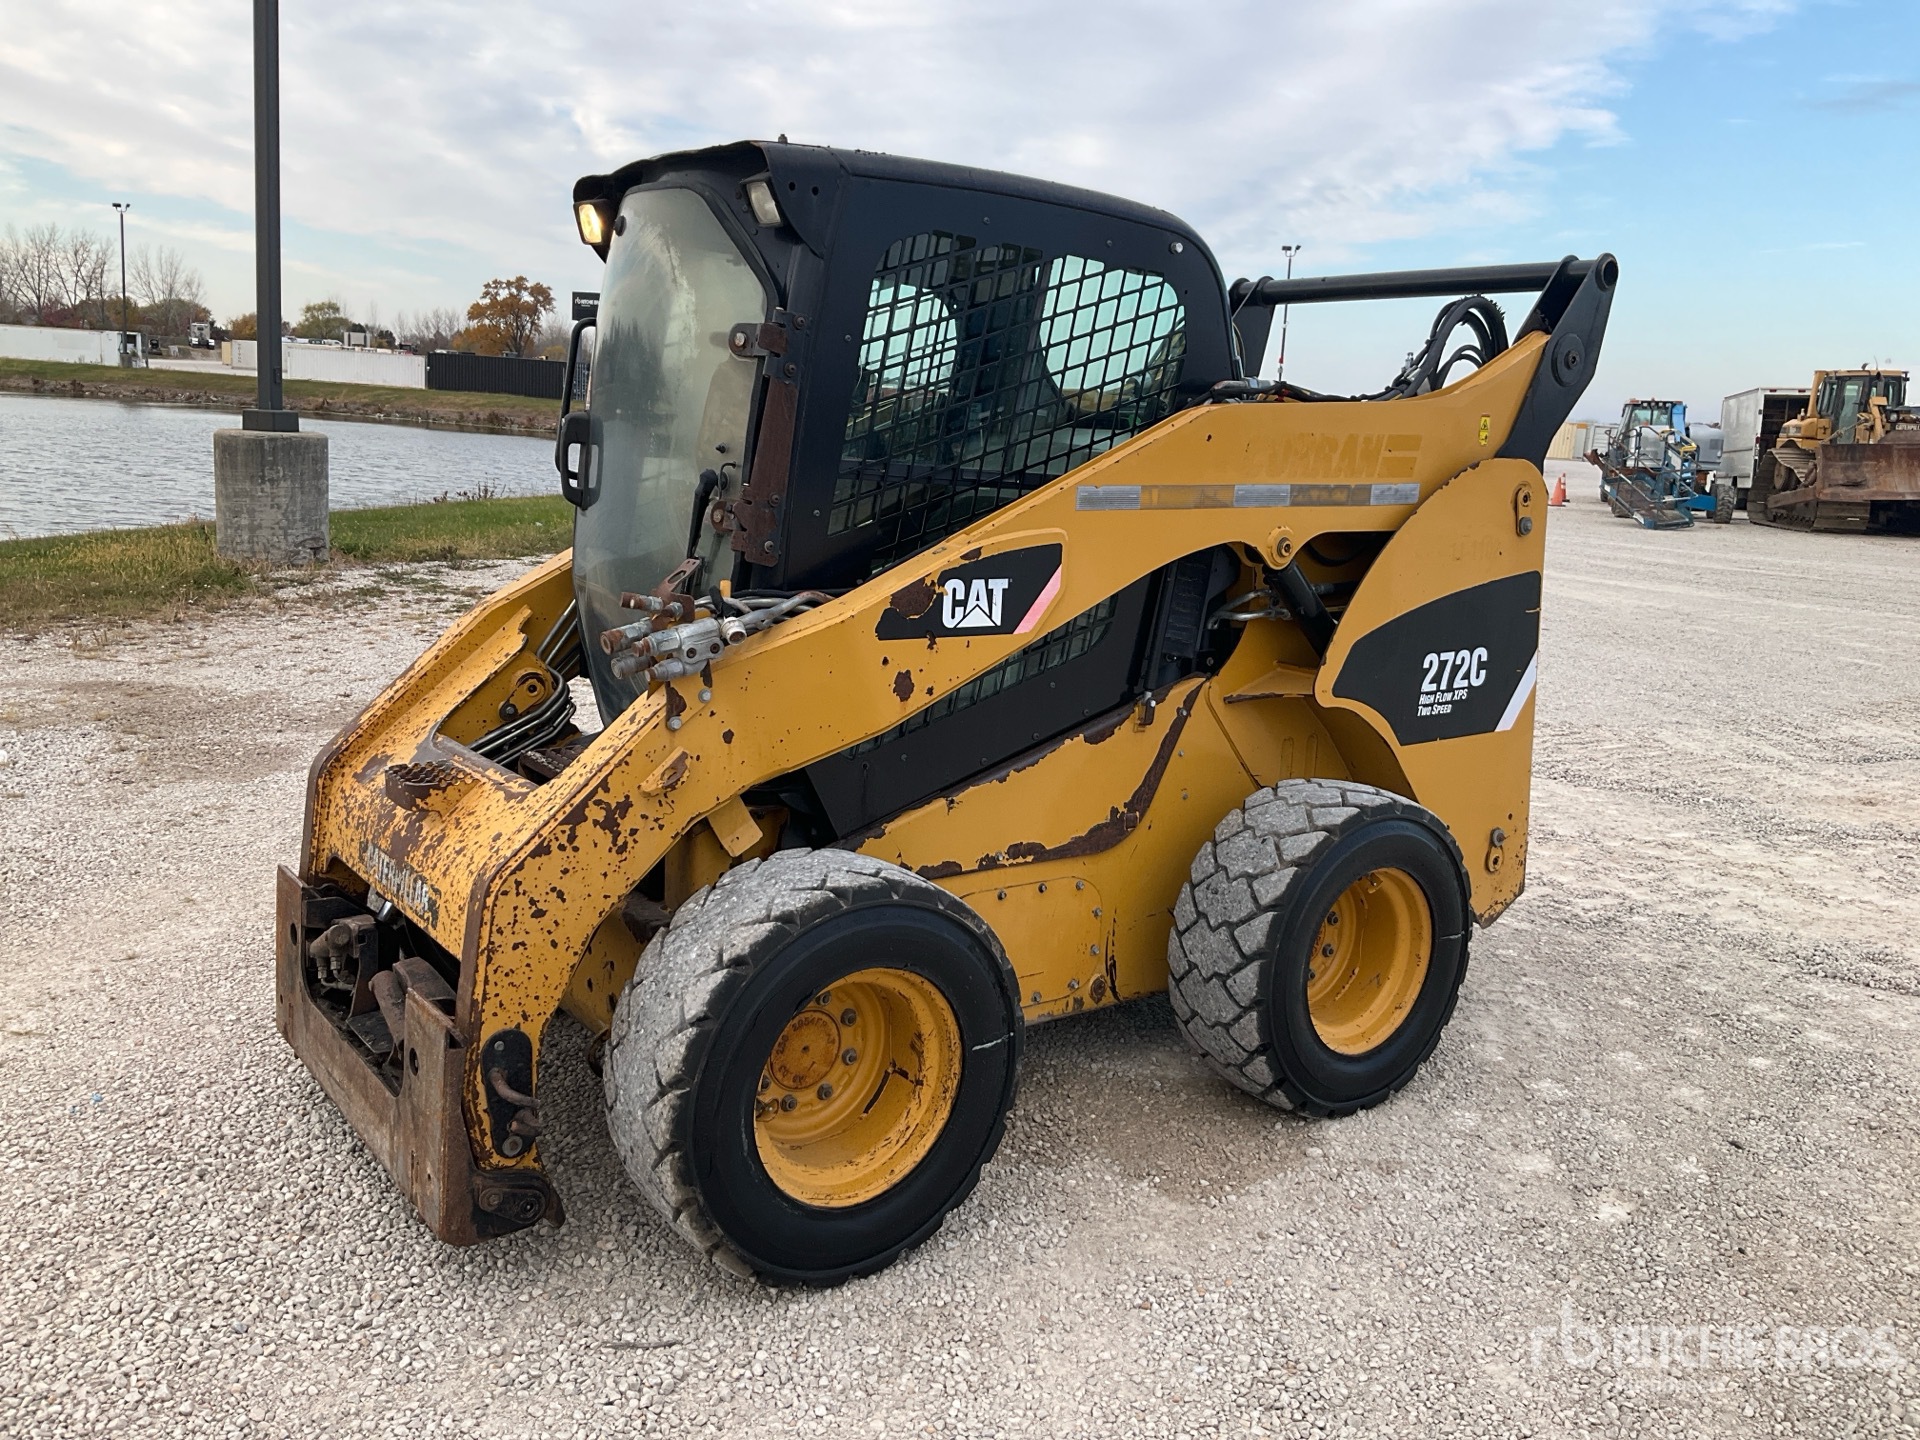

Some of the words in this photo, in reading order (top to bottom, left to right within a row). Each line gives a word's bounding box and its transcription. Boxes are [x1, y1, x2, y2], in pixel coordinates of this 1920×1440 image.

[942, 578, 1009, 629] CAT
[1420, 646, 1488, 693] 272C
[1452, 688, 1468, 701] XPS
